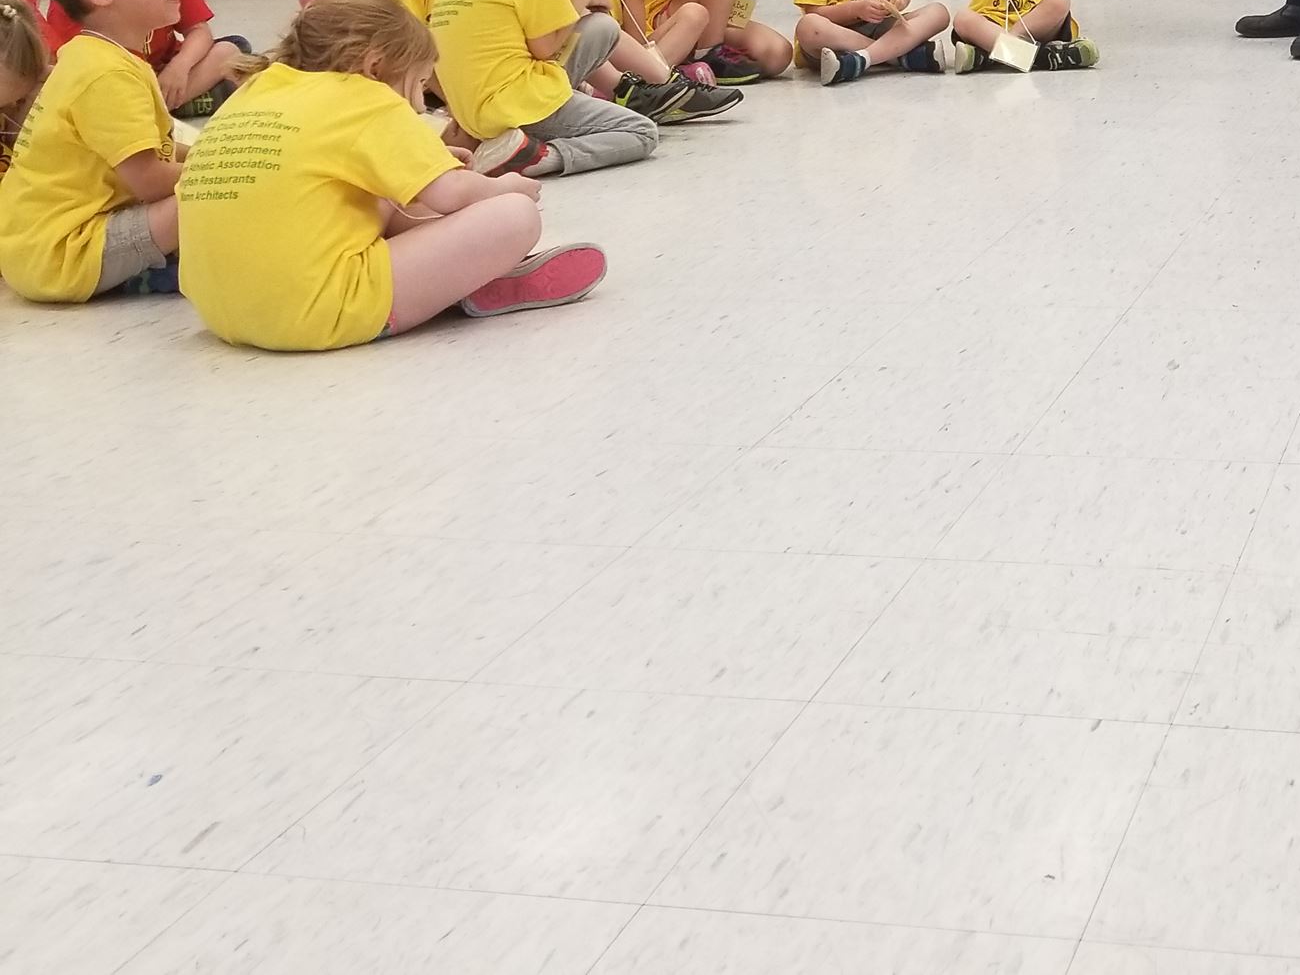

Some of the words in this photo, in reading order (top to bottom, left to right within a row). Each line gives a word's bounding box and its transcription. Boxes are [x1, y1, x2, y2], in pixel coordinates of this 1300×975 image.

[237, 119, 249, 130] of
[251, 120, 302, 133] Fairlawn
[219, 131, 282, 144] Department
[218, 146, 283, 158] Department
[217, 159, 281, 172] Association
[199, 173, 257, 187] Restaurants
[195, 189, 240, 201] Architects
